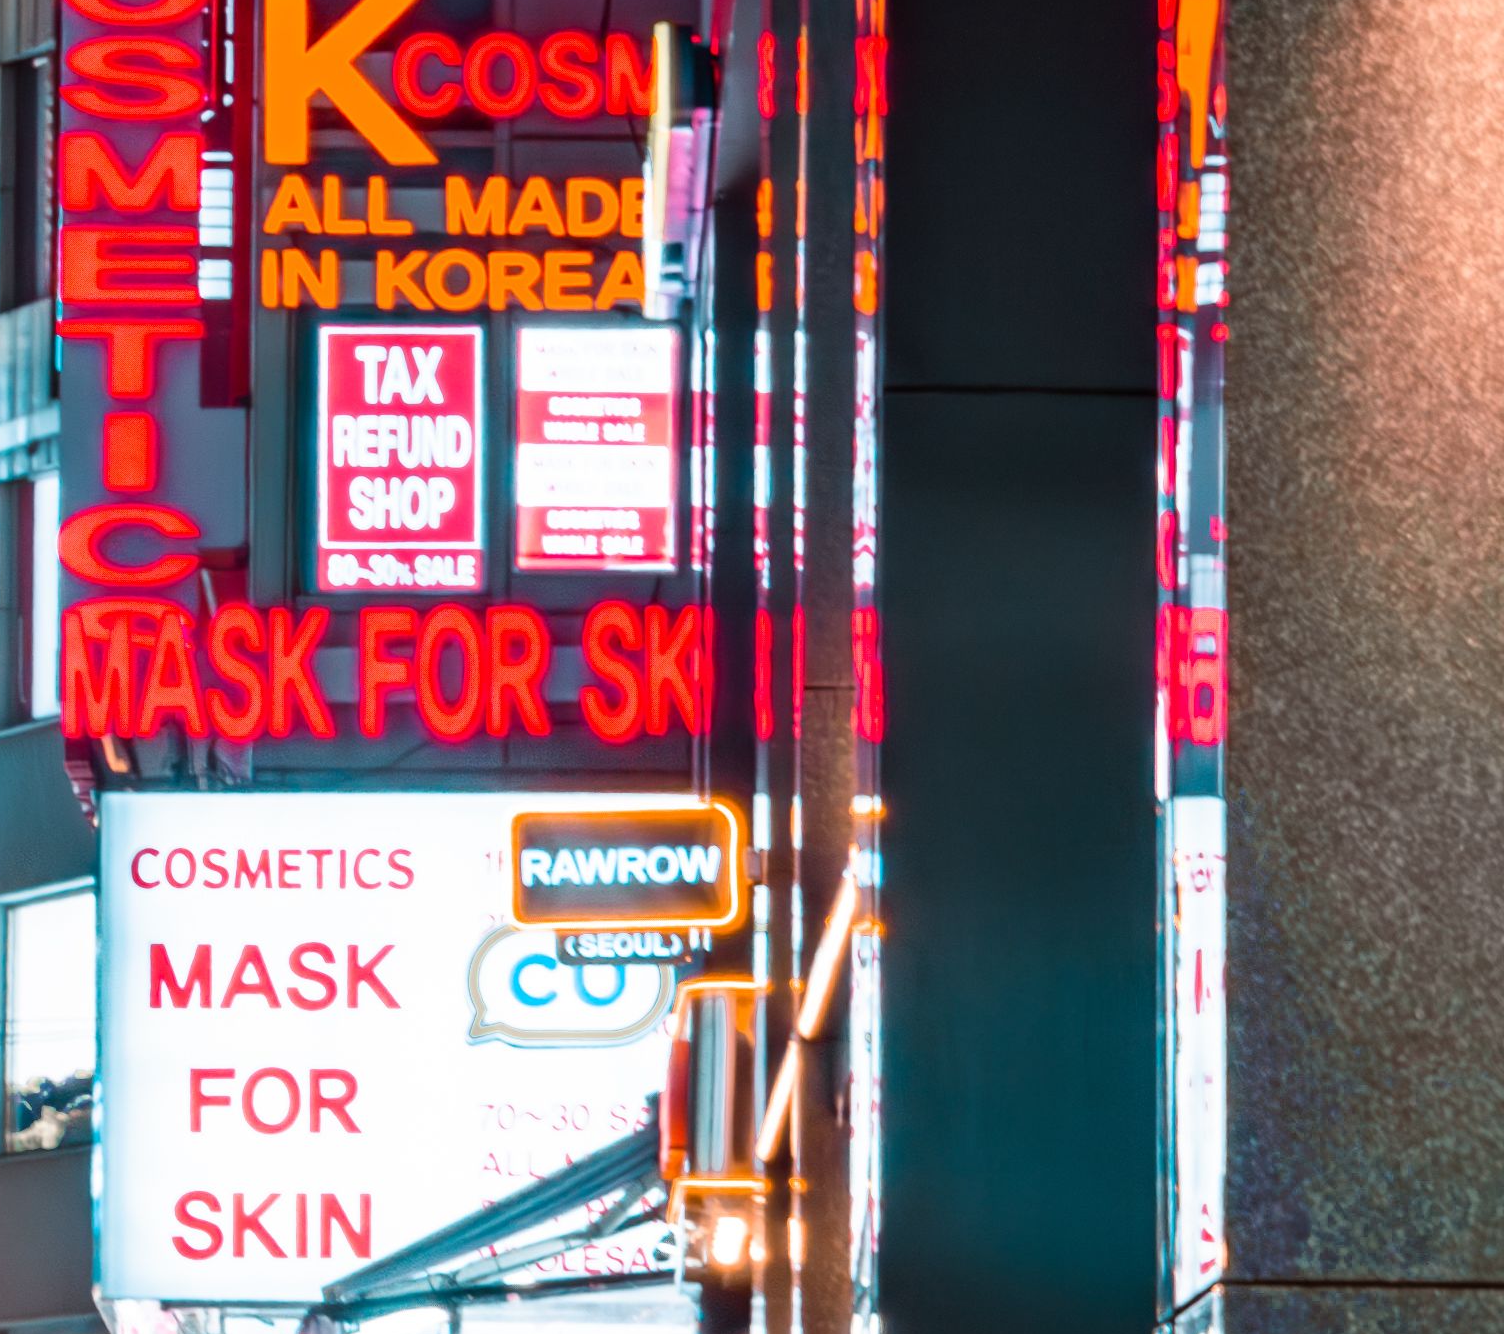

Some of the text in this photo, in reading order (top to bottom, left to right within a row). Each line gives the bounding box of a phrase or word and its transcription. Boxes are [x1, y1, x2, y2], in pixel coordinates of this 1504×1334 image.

[263, 175, 413, 237] ALL
[261, 249, 645, 313] IN KOREA
[354, 345, 446, 406] TAX
[332, 414, 472, 470] REFUND
[348, 475, 455, 532] SHOP
[413, 555, 477, 587] SALE
[61, 606, 337, 741] MASK
[358, 602, 553, 744] FOR
[130, 847, 416, 891] COSMETICS
[520, 844, 723, 889] RAWROW
[148, 941, 402, 1011] MASK
[187, 1067, 362, 1136] FOR
[170, 1189, 375, 1262] SKIN
